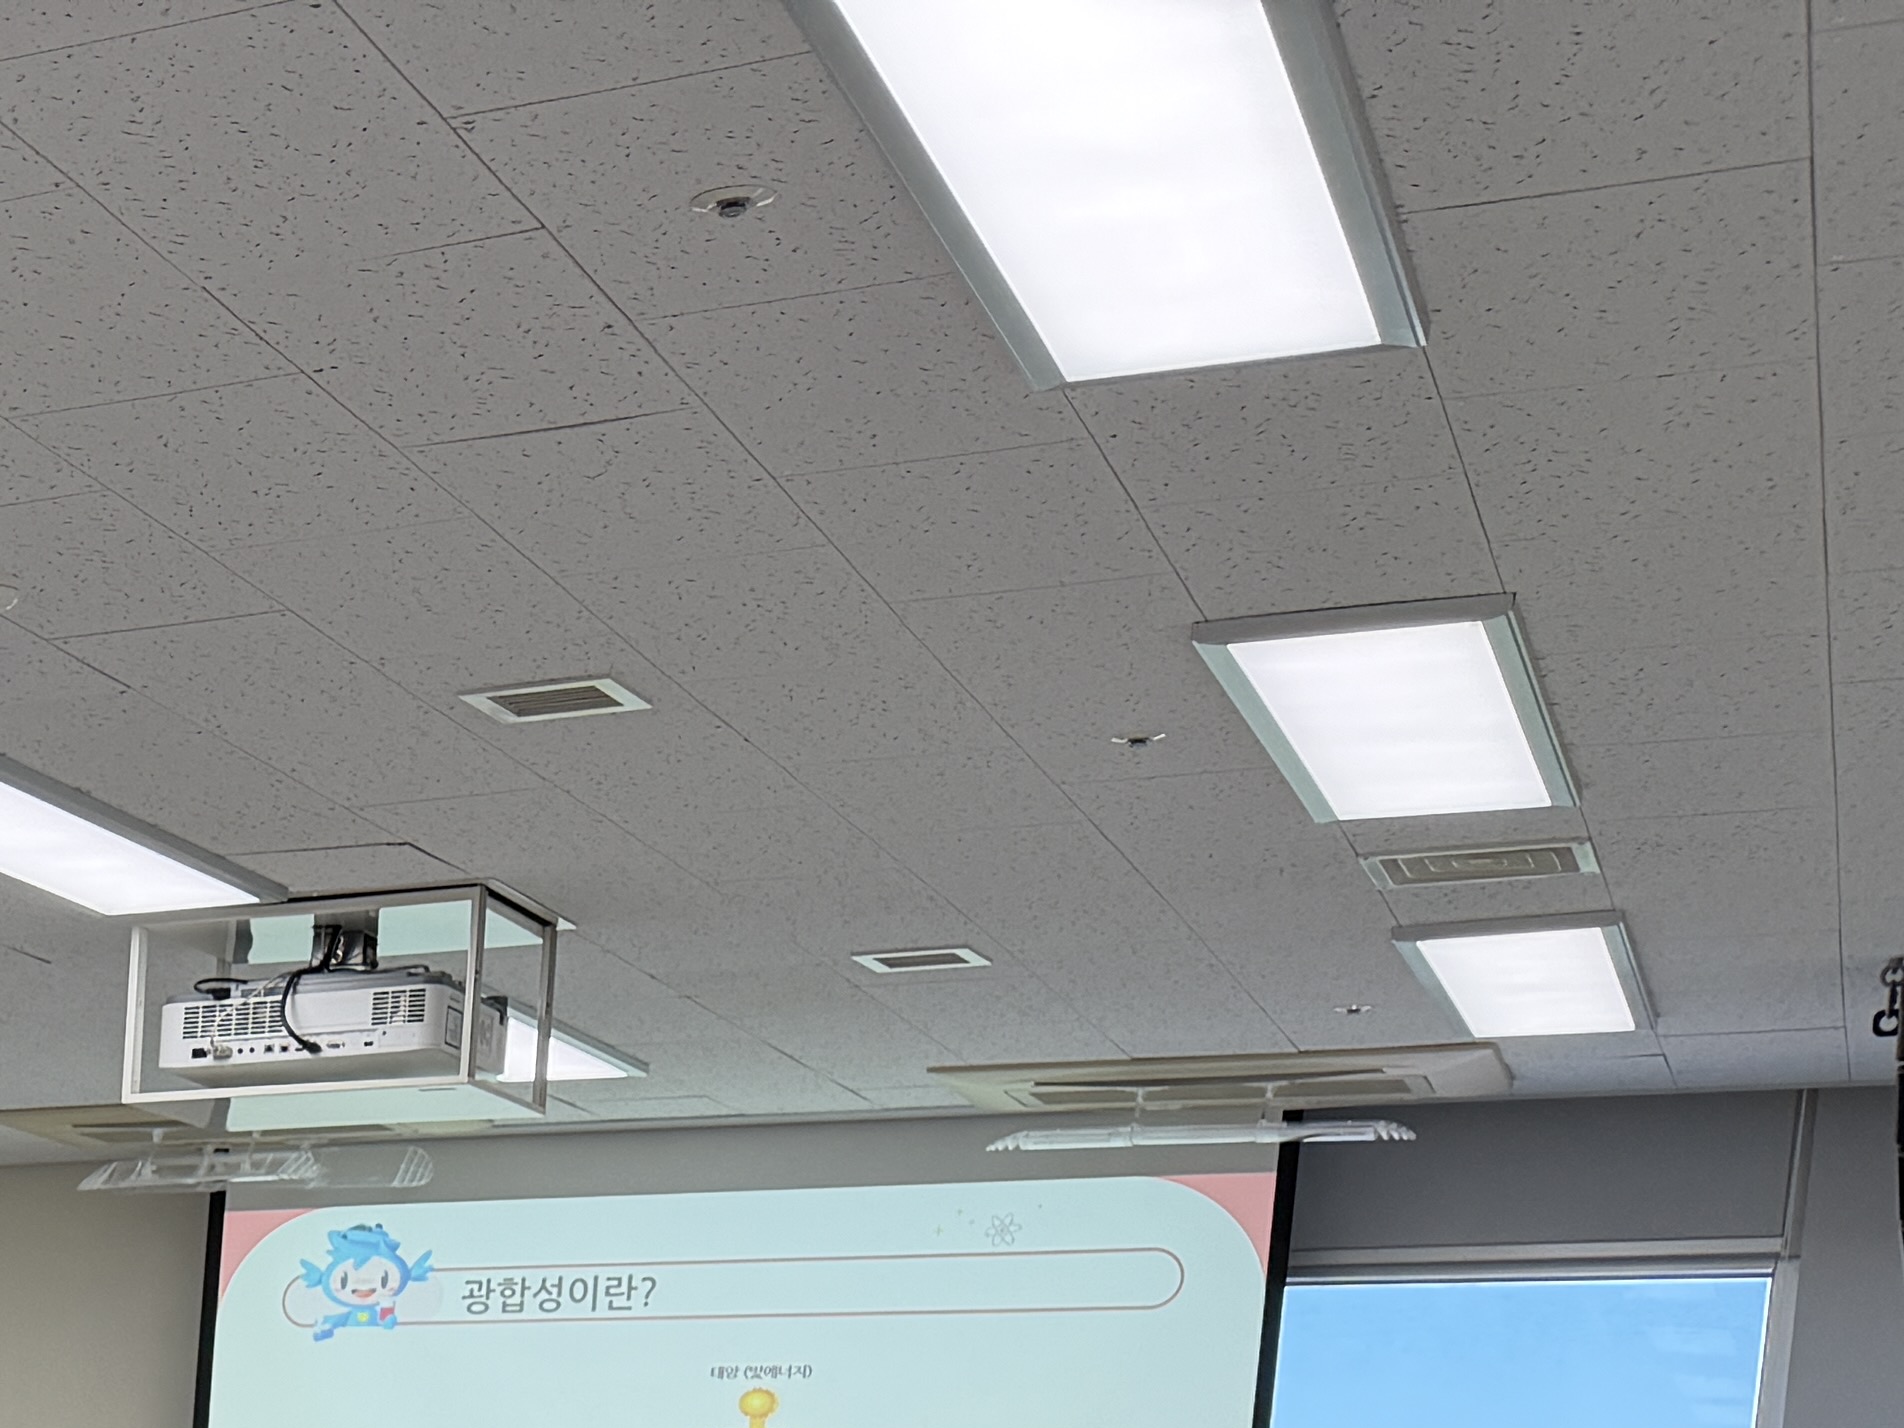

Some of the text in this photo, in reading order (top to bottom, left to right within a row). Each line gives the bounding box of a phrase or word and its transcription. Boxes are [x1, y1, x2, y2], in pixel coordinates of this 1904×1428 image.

[461, 1273, 658, 1315] 광합성이란?
[710, 1363, 813, 1380] 태양 (빛에너지)
